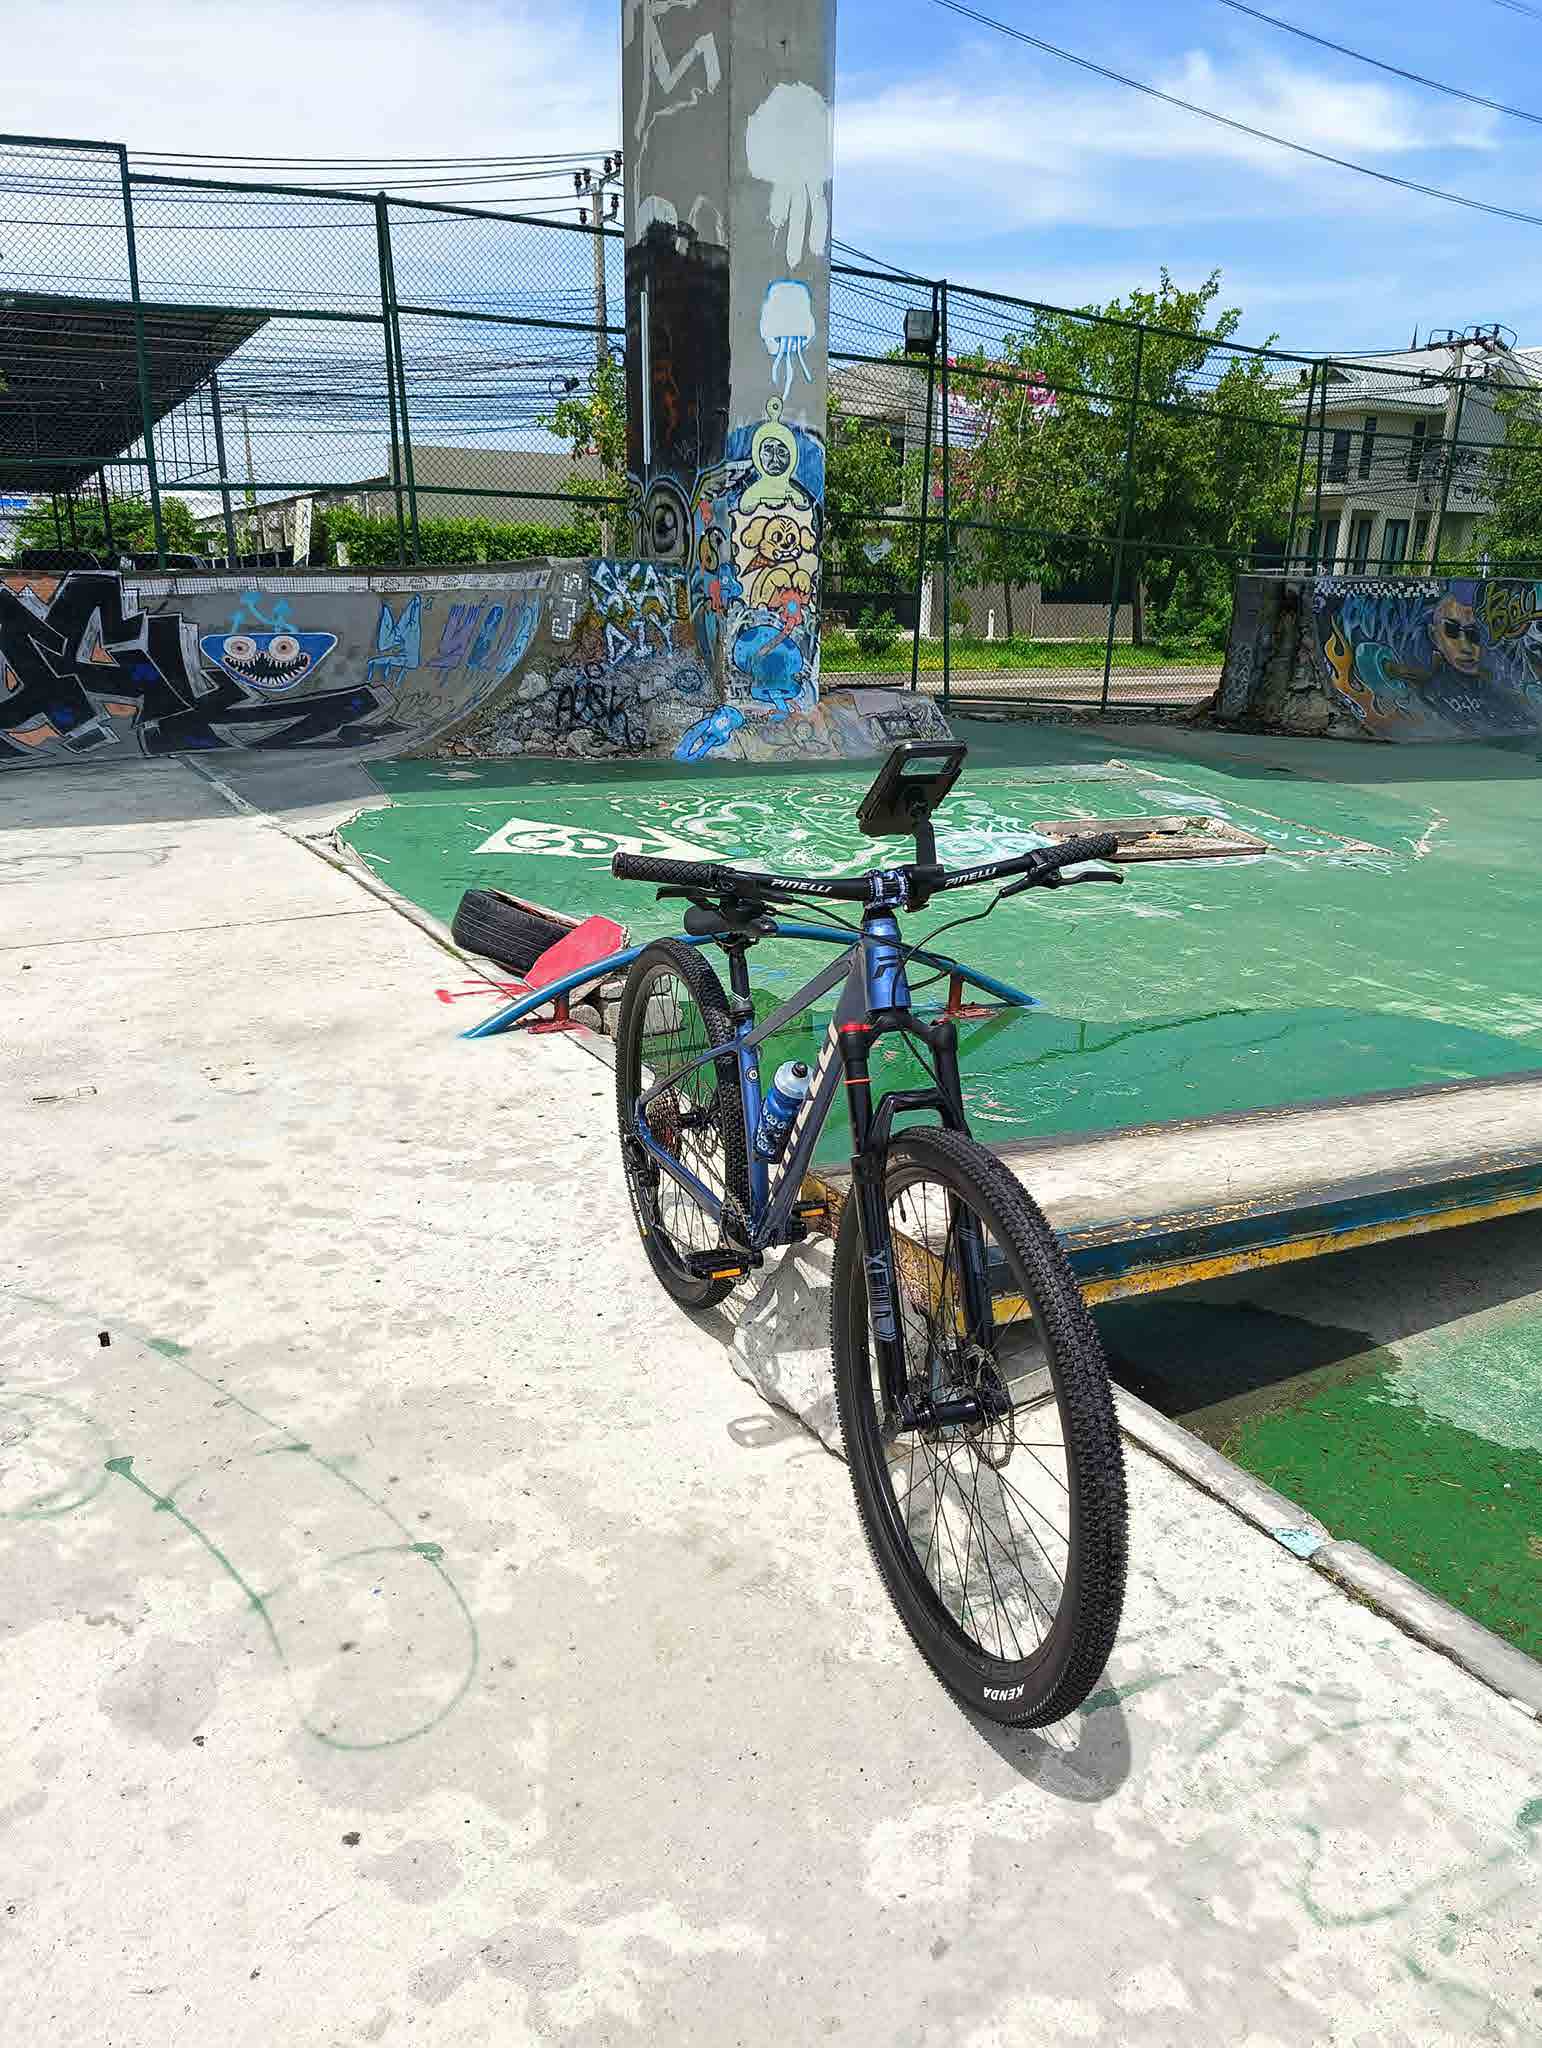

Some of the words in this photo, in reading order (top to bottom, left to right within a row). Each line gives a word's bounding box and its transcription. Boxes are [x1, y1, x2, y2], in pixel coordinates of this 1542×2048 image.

[770, 878, 833, 893] PINELLI
[945, 866, 998, 888] PINELLI
[983, 1684, 1025, 1701] KENDA
